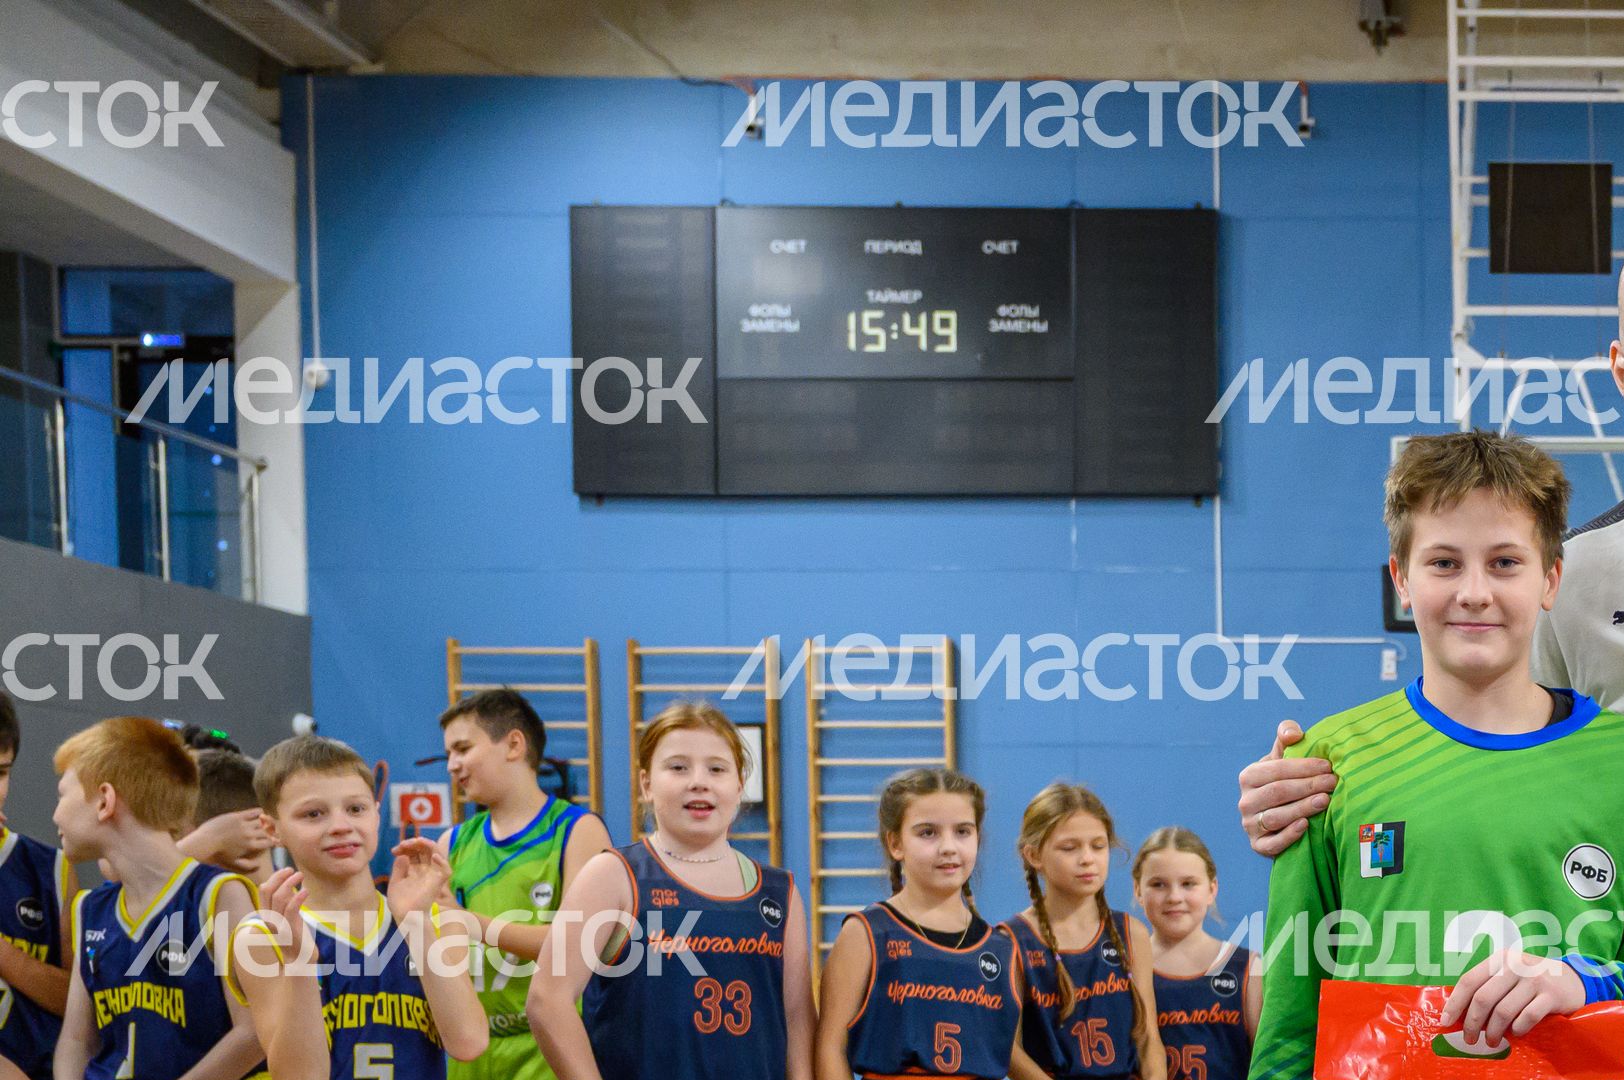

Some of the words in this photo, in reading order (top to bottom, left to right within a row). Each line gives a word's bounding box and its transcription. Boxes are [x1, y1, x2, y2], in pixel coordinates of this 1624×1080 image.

[770, 239, 808, 253] СЧЕТ
[864, 240, 923, 255] ПЕРИОД
[981, 239, 1019, 254] СЧЕТ
[867, 288, 923, 303] ТАЙМЕР
[748, 304, 792, 318] ФОЛЫ
[997, 304, 1040, 318] ФОЛЫ
[740, 319, 800, 333] ЗАМЕНЫ
[848, 310, 957, 352] 15:49
[989, 319, 1049, 333] ЗАМЕНЫ
[1570, 861, 1608, 883] РФБ
[648, 928, 783, 960] Черноголовка
[887, 980, 1004, 1010] Черноголовка
[694, 977, 752, 1035] 33
[934, 1022, 962, 1074] 5
[1071, 1018, 1116, 1068] 15
